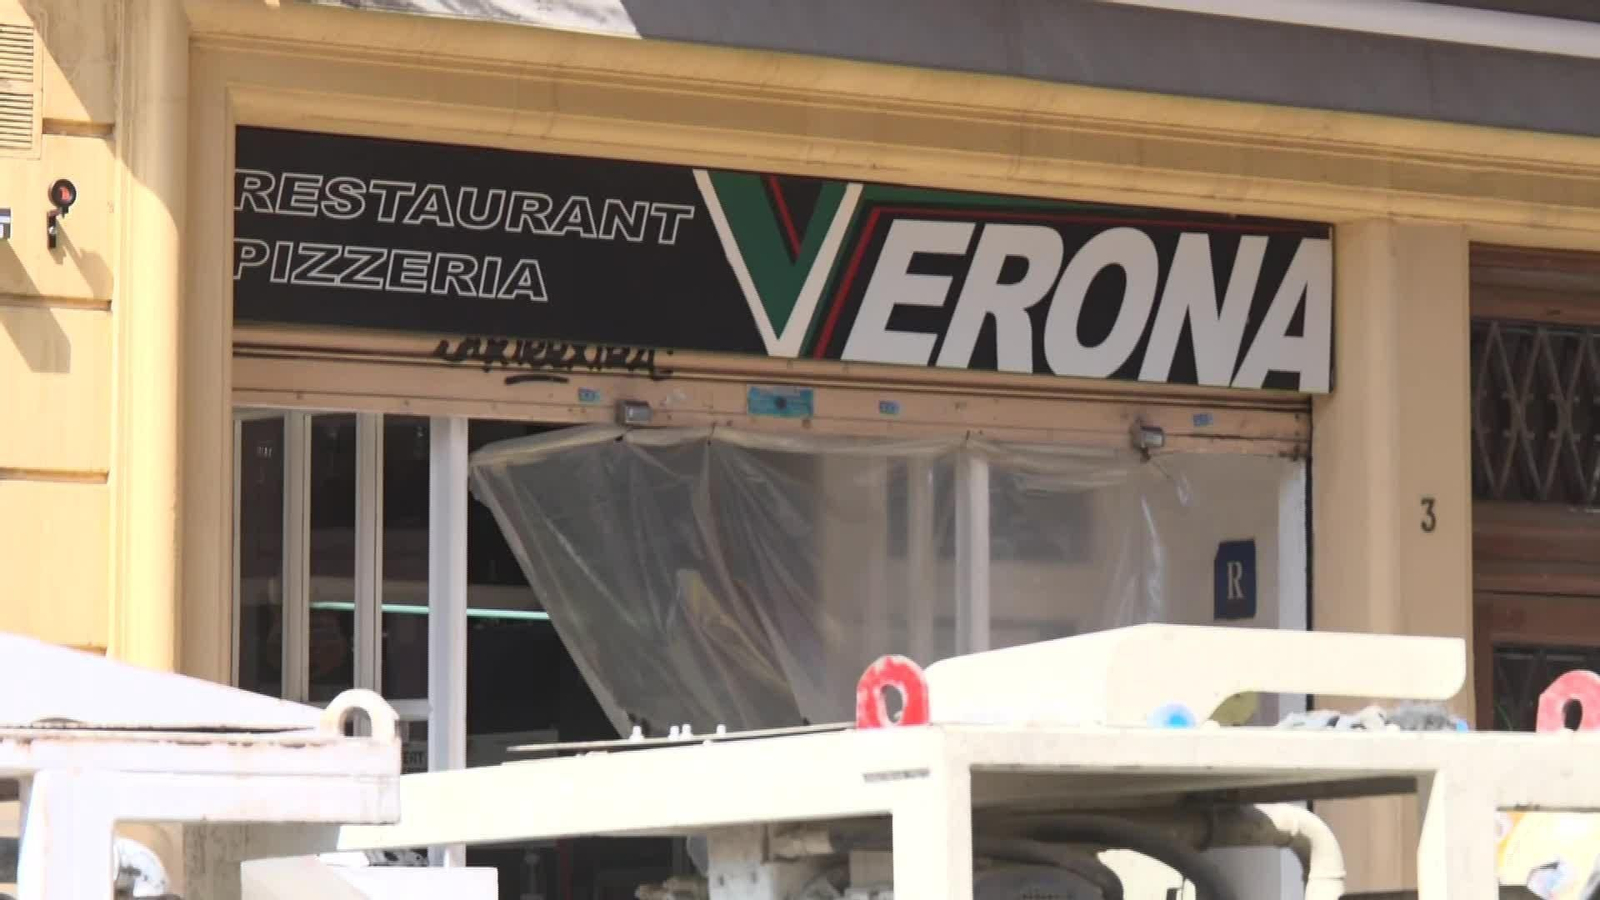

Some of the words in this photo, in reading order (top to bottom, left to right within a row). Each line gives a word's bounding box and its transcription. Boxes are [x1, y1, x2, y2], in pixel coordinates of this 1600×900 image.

[234, 168, 695, 245] RESTAURANT
[233, 238, 548, 301] PIZZERIA
[693, 168, 1332, 393] VERONA
[1420, 497, 1437, 533] 3
[1226, 560, 1244, 601] R
